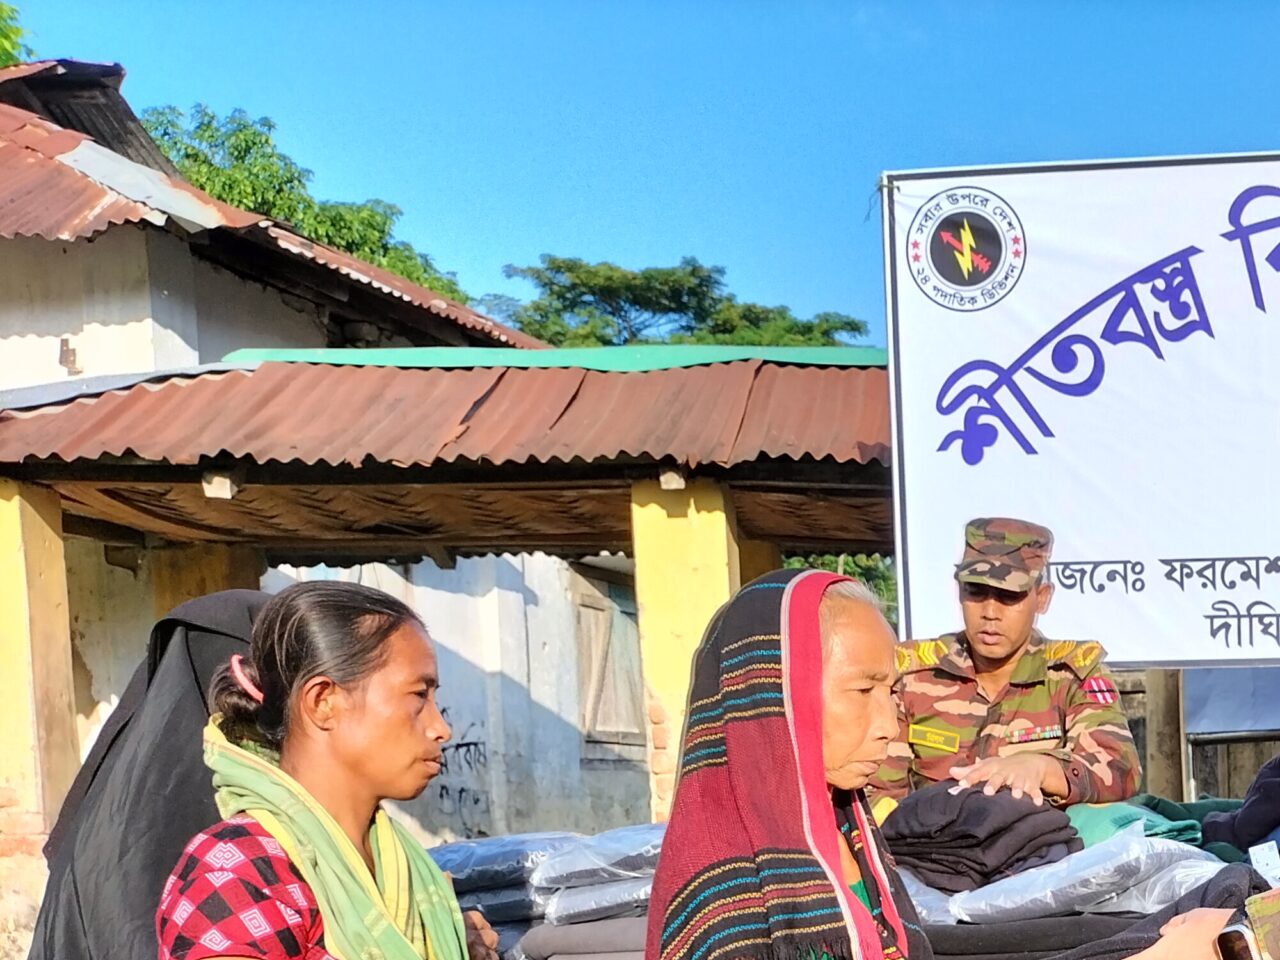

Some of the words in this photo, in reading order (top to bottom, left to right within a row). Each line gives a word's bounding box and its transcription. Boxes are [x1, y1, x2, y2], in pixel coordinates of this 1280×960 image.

[915, 201, 943, 235] সবার
[945, 192, 991, 208] উপরে
[992, 205, 1017, 233] দেশ
[932, 285, 978, 307] পদাতিক
[980, 262, 1019, 304] ডিভিশন
[936, 245, 1215, 466] শীতবস্ত্র
